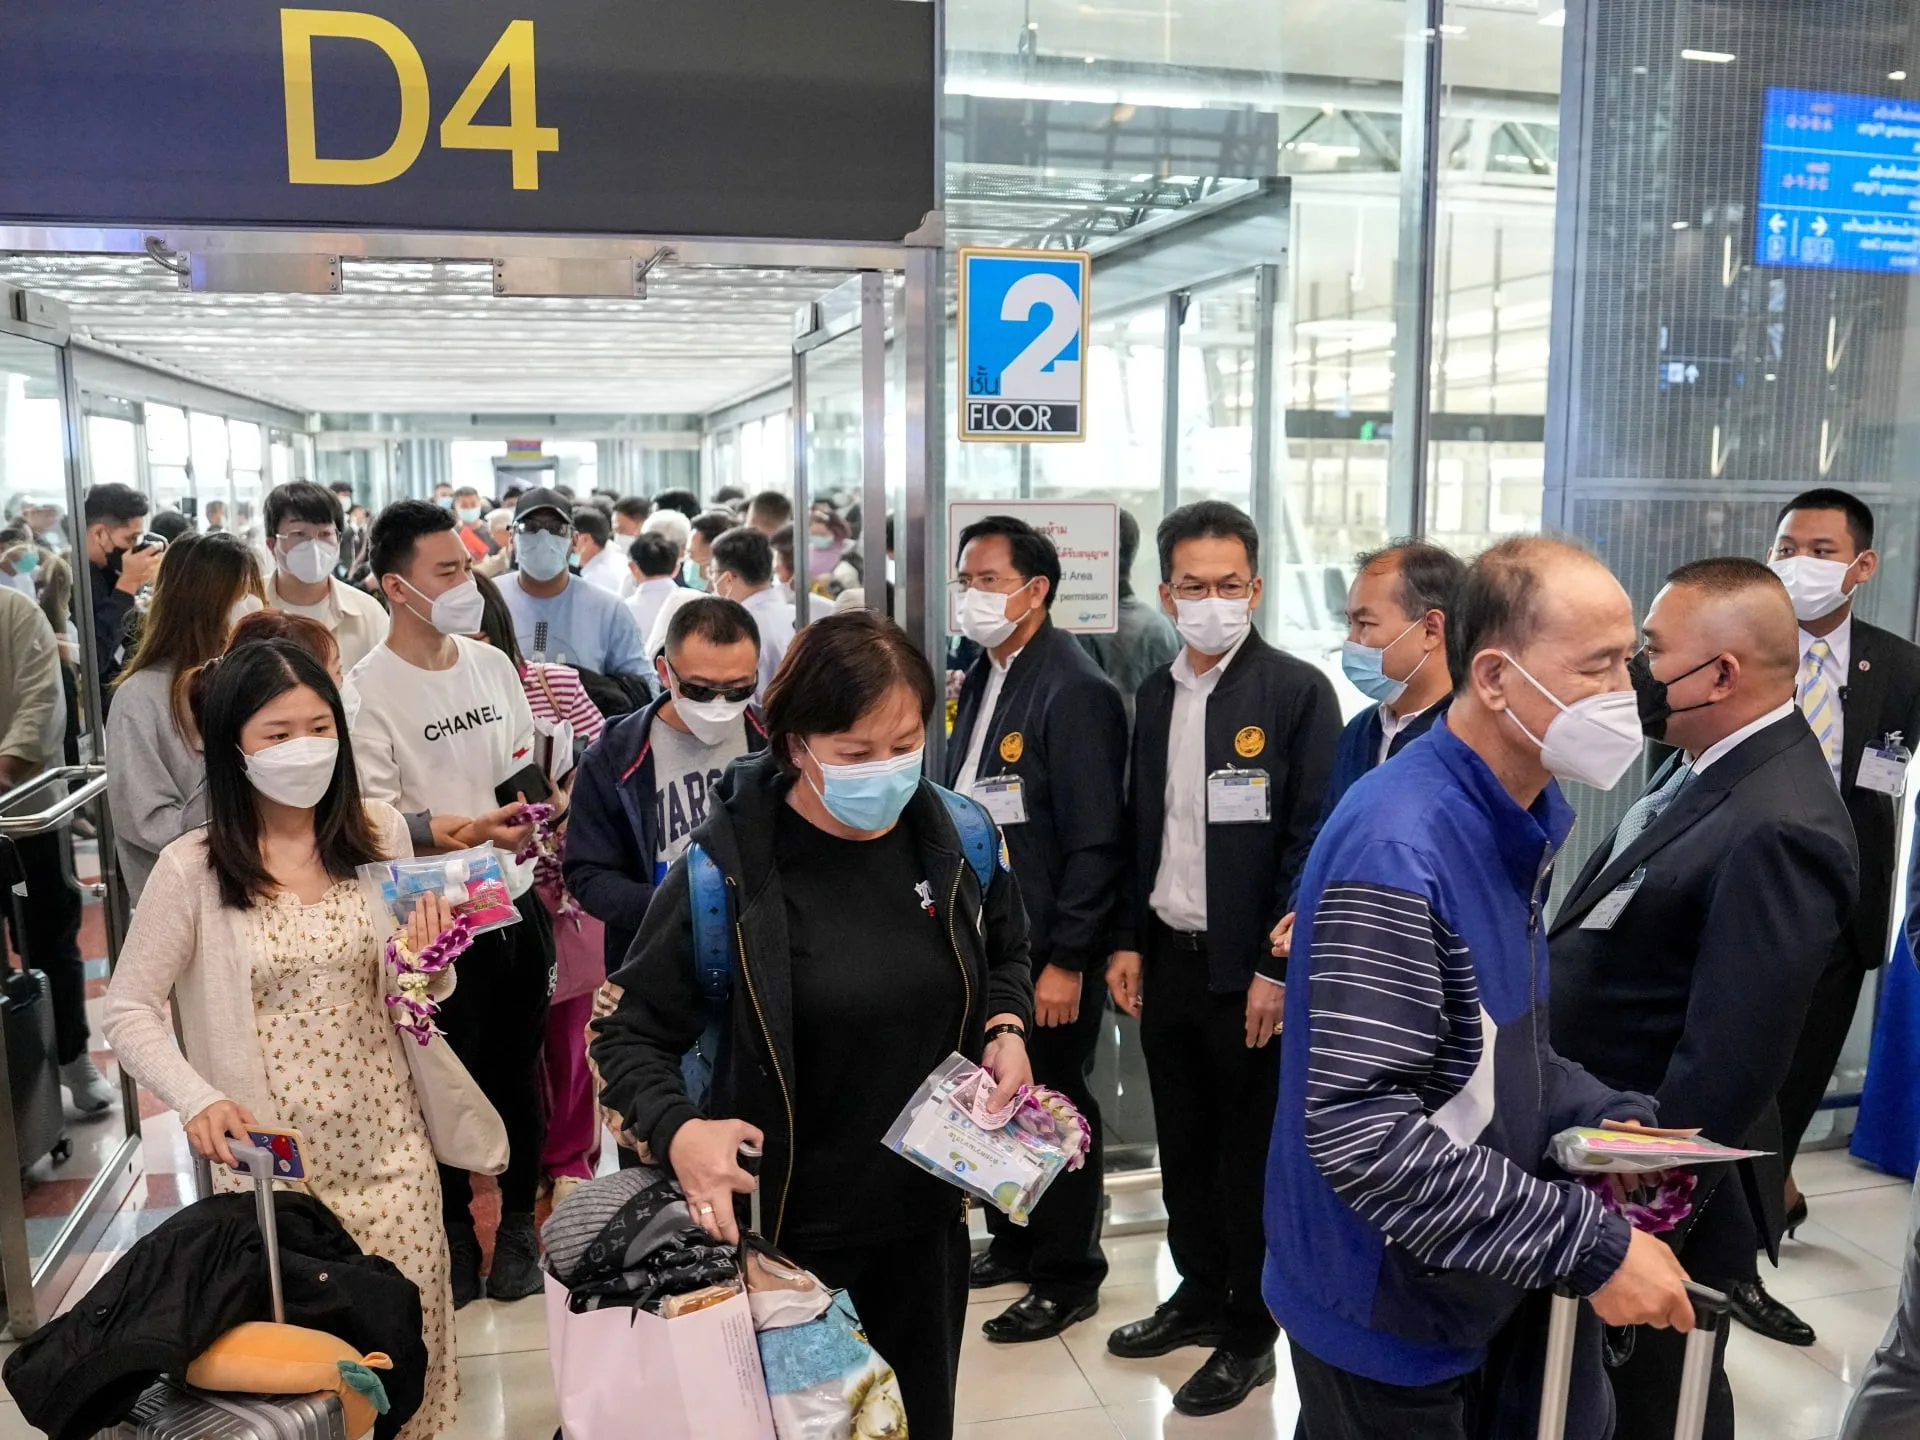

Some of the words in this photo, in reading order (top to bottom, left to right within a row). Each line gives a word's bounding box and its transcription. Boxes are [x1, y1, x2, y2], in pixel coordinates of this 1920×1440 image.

[280, 8, 559, 190] D4
[1000, 272, 1082, 399] 2
[970, 365, 999, 395] ชั้น
[969, 404, 1052, 431] FLOOR
[1069, 570, 1093, 581] Area
[1060, 592, 1108, 604] permission
[424, 704, 503, 741] CHANEL
